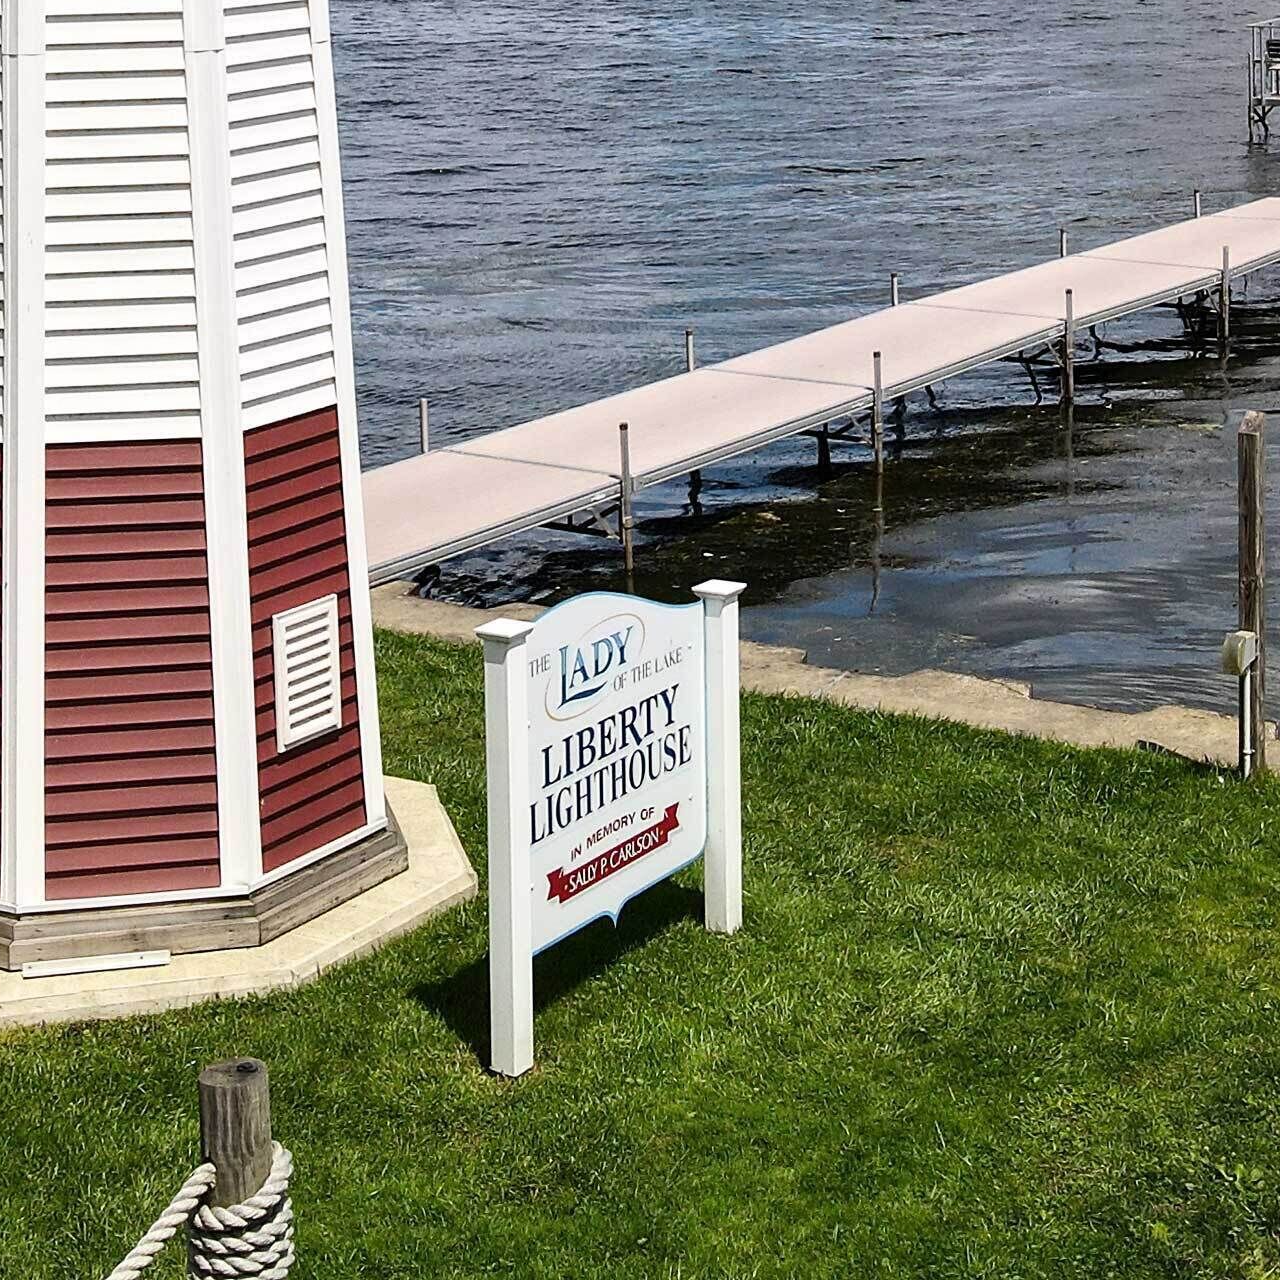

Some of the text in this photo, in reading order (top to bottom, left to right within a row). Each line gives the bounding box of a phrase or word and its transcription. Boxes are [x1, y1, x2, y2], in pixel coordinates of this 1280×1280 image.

[529, 625, 634, 710] THE LADY
[613, 646, 684, 692] OF THE LAKE
[541, 683, 680, 789] LIBERTY
[529, 724, 693, 846] LIGHTHOUSE
[568, 861, 598, 893] SALLY
[609, 827, 660, 868] CARLSON
[570, 806, 655, 862] IN MEMORY OF
